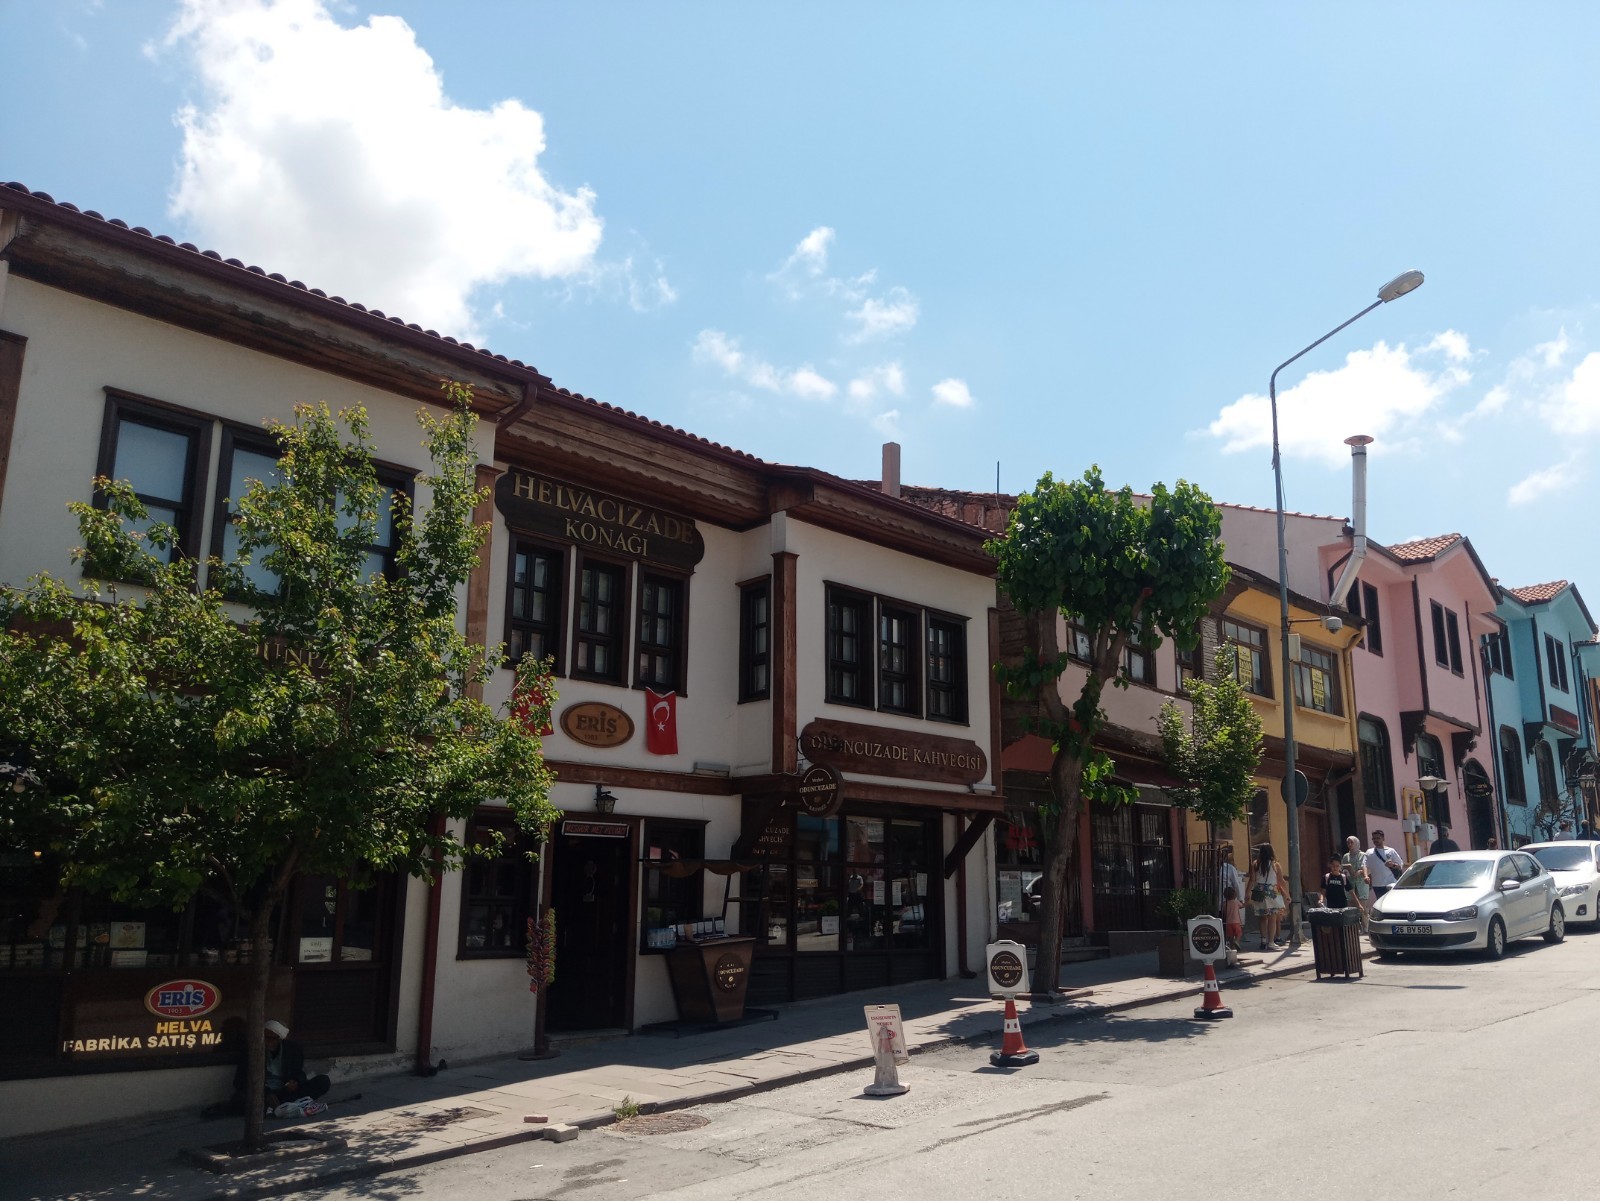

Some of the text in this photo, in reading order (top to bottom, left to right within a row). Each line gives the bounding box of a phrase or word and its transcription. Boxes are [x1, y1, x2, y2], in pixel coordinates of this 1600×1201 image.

[512, 473, 695, 545] HELVACIZADE
[565, 517, 648, 557] KONAĞI
[913, 749, 981, 770] KAHVECİSİ
[799, 783, 837, 793] ODUNCUZADE
[1406, 926, 1416, 934] BV
[156, 1019, 212, 1034] HELVA
[63, 1035, 142, 1053] FABRİKA
[147, 1033, 197, 1049] SATIŞ
